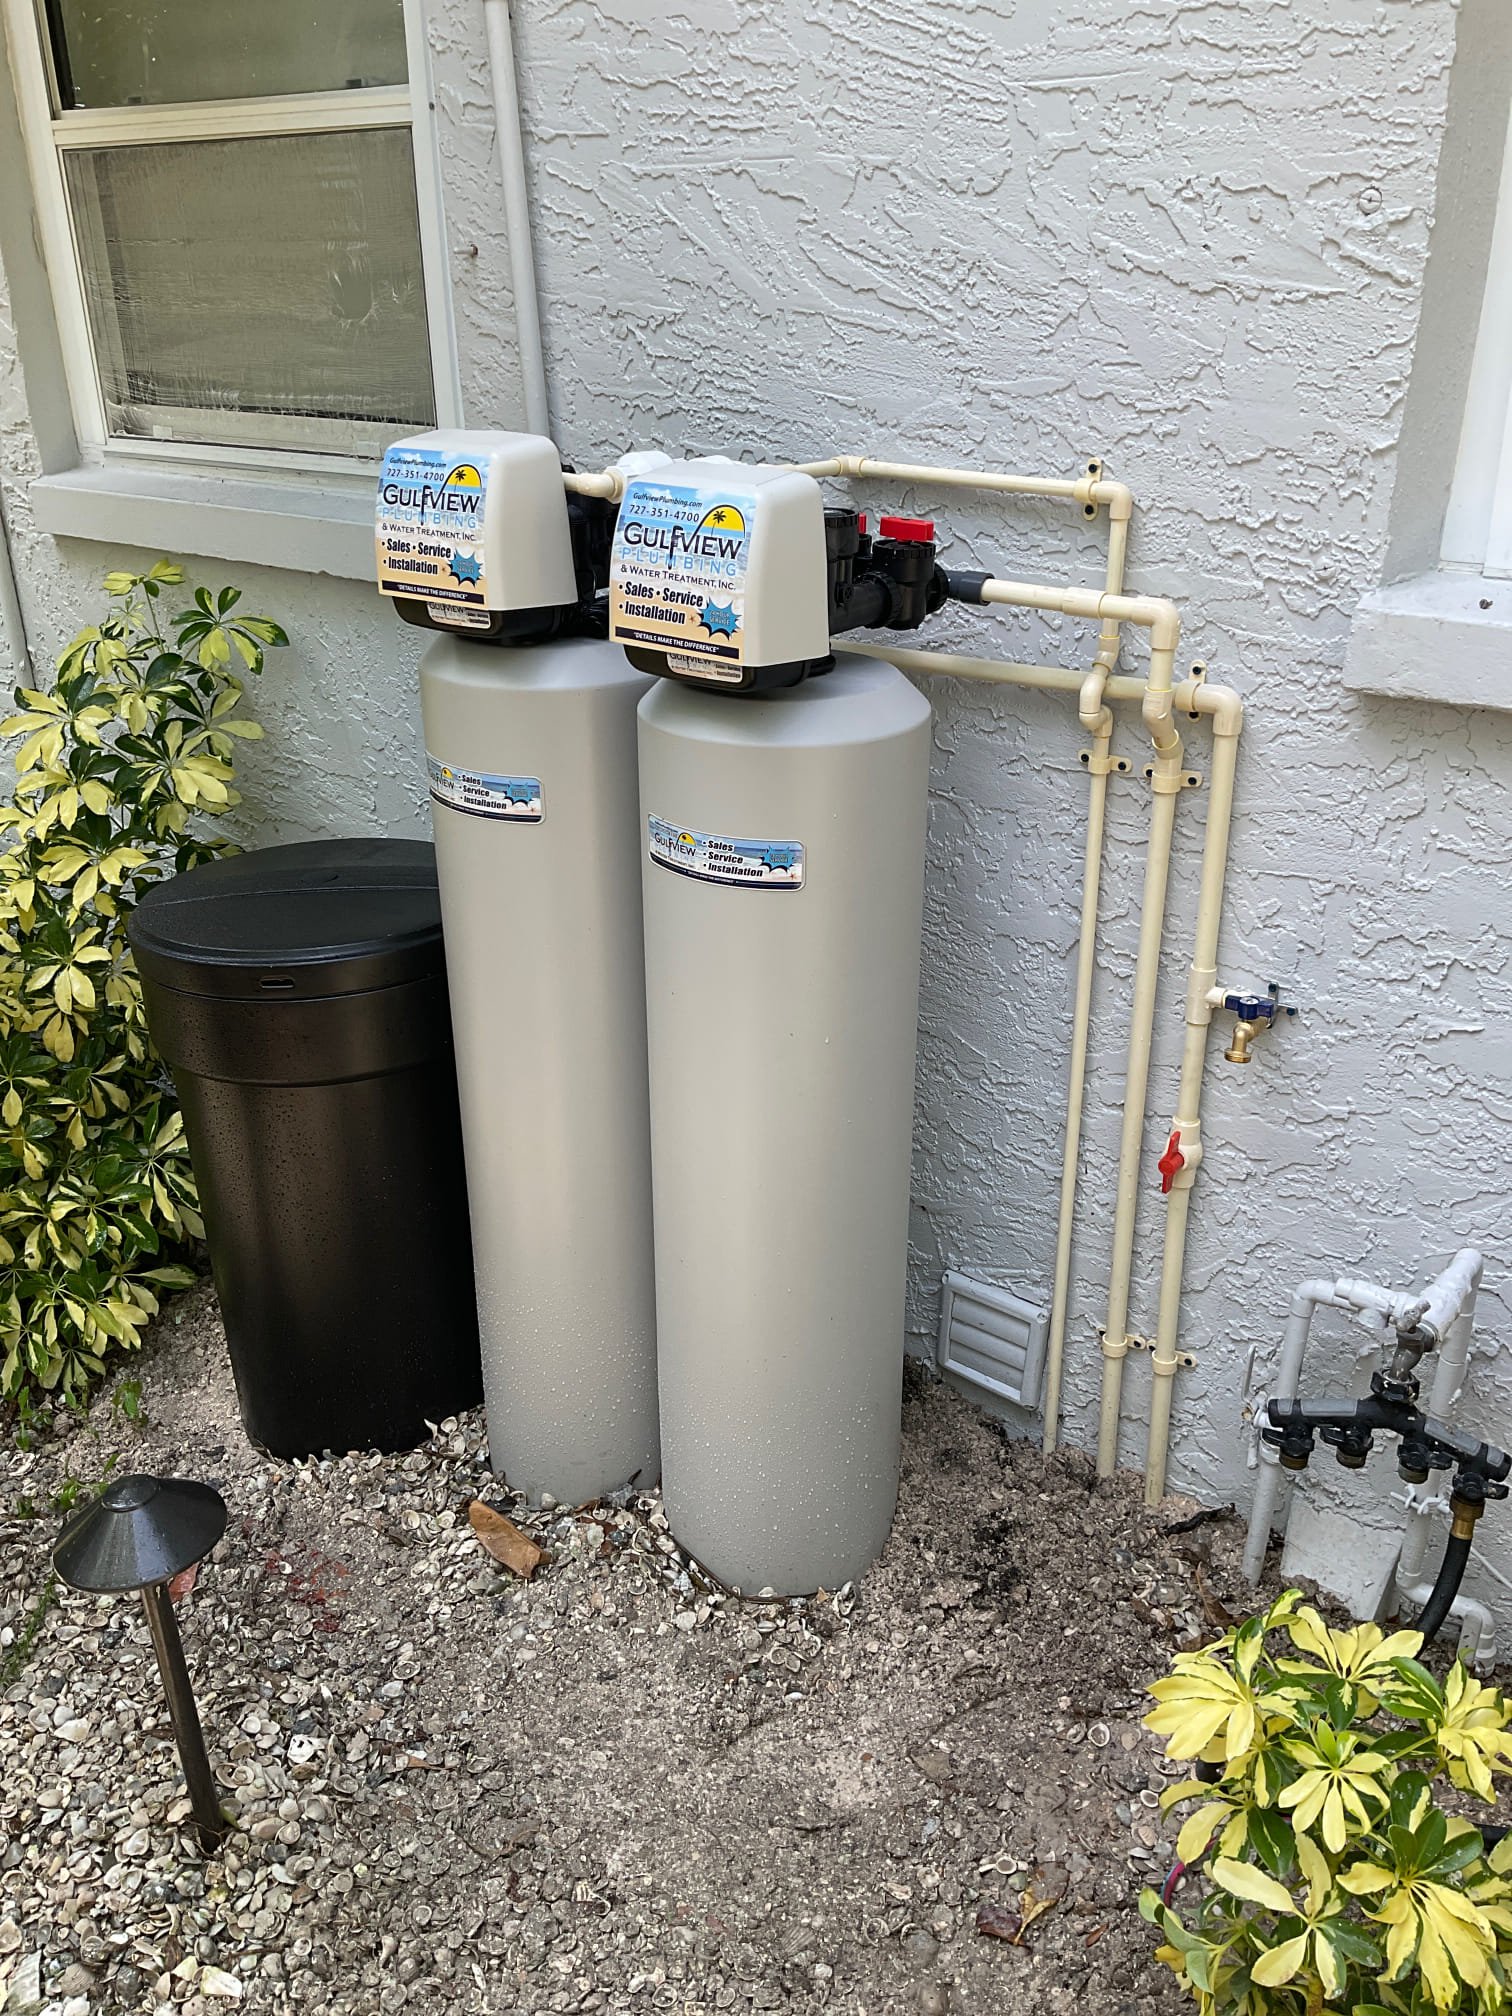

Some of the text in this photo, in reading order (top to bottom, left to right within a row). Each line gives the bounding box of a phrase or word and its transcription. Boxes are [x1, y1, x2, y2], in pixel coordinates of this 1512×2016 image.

[387, 468, 445, 482] 727-351-4700
[383, 484, 480, 513] GULFVIEW
[633, 492, 703, 508] GulfviewPlumbing.com
[382, 507, 476, 528] PLUMBING
[629, 505, 700, 522] 727-351-4700
[390, 524, 414, 533] WATER
[387, 538, 451, 558] Sales Service
[624, 522, 743, 560] GULFVIEW
[389, 557, 438, 574] Installation
[621, 547, 737, 576] PLUMBING
[620, 564, 627, 573] &
[630, 565, 661, 578] WATER
[718, 580, 736, 591] INC.
[625, 581, 704, 607] Sales Service
[625, 601, 686, 624] Installation
[657, 636, 672, 645] MAKE
[673, 639, 684, 647] THE
[462, 774, 481, 785] Sales
[463, 785, 490, 797] Service
[464, 796, 507, 809] Installation
[708, 840, 734, 851] Sales
[708, 852, 743, 864] Service
[708, 862, 763, 877] Installation
